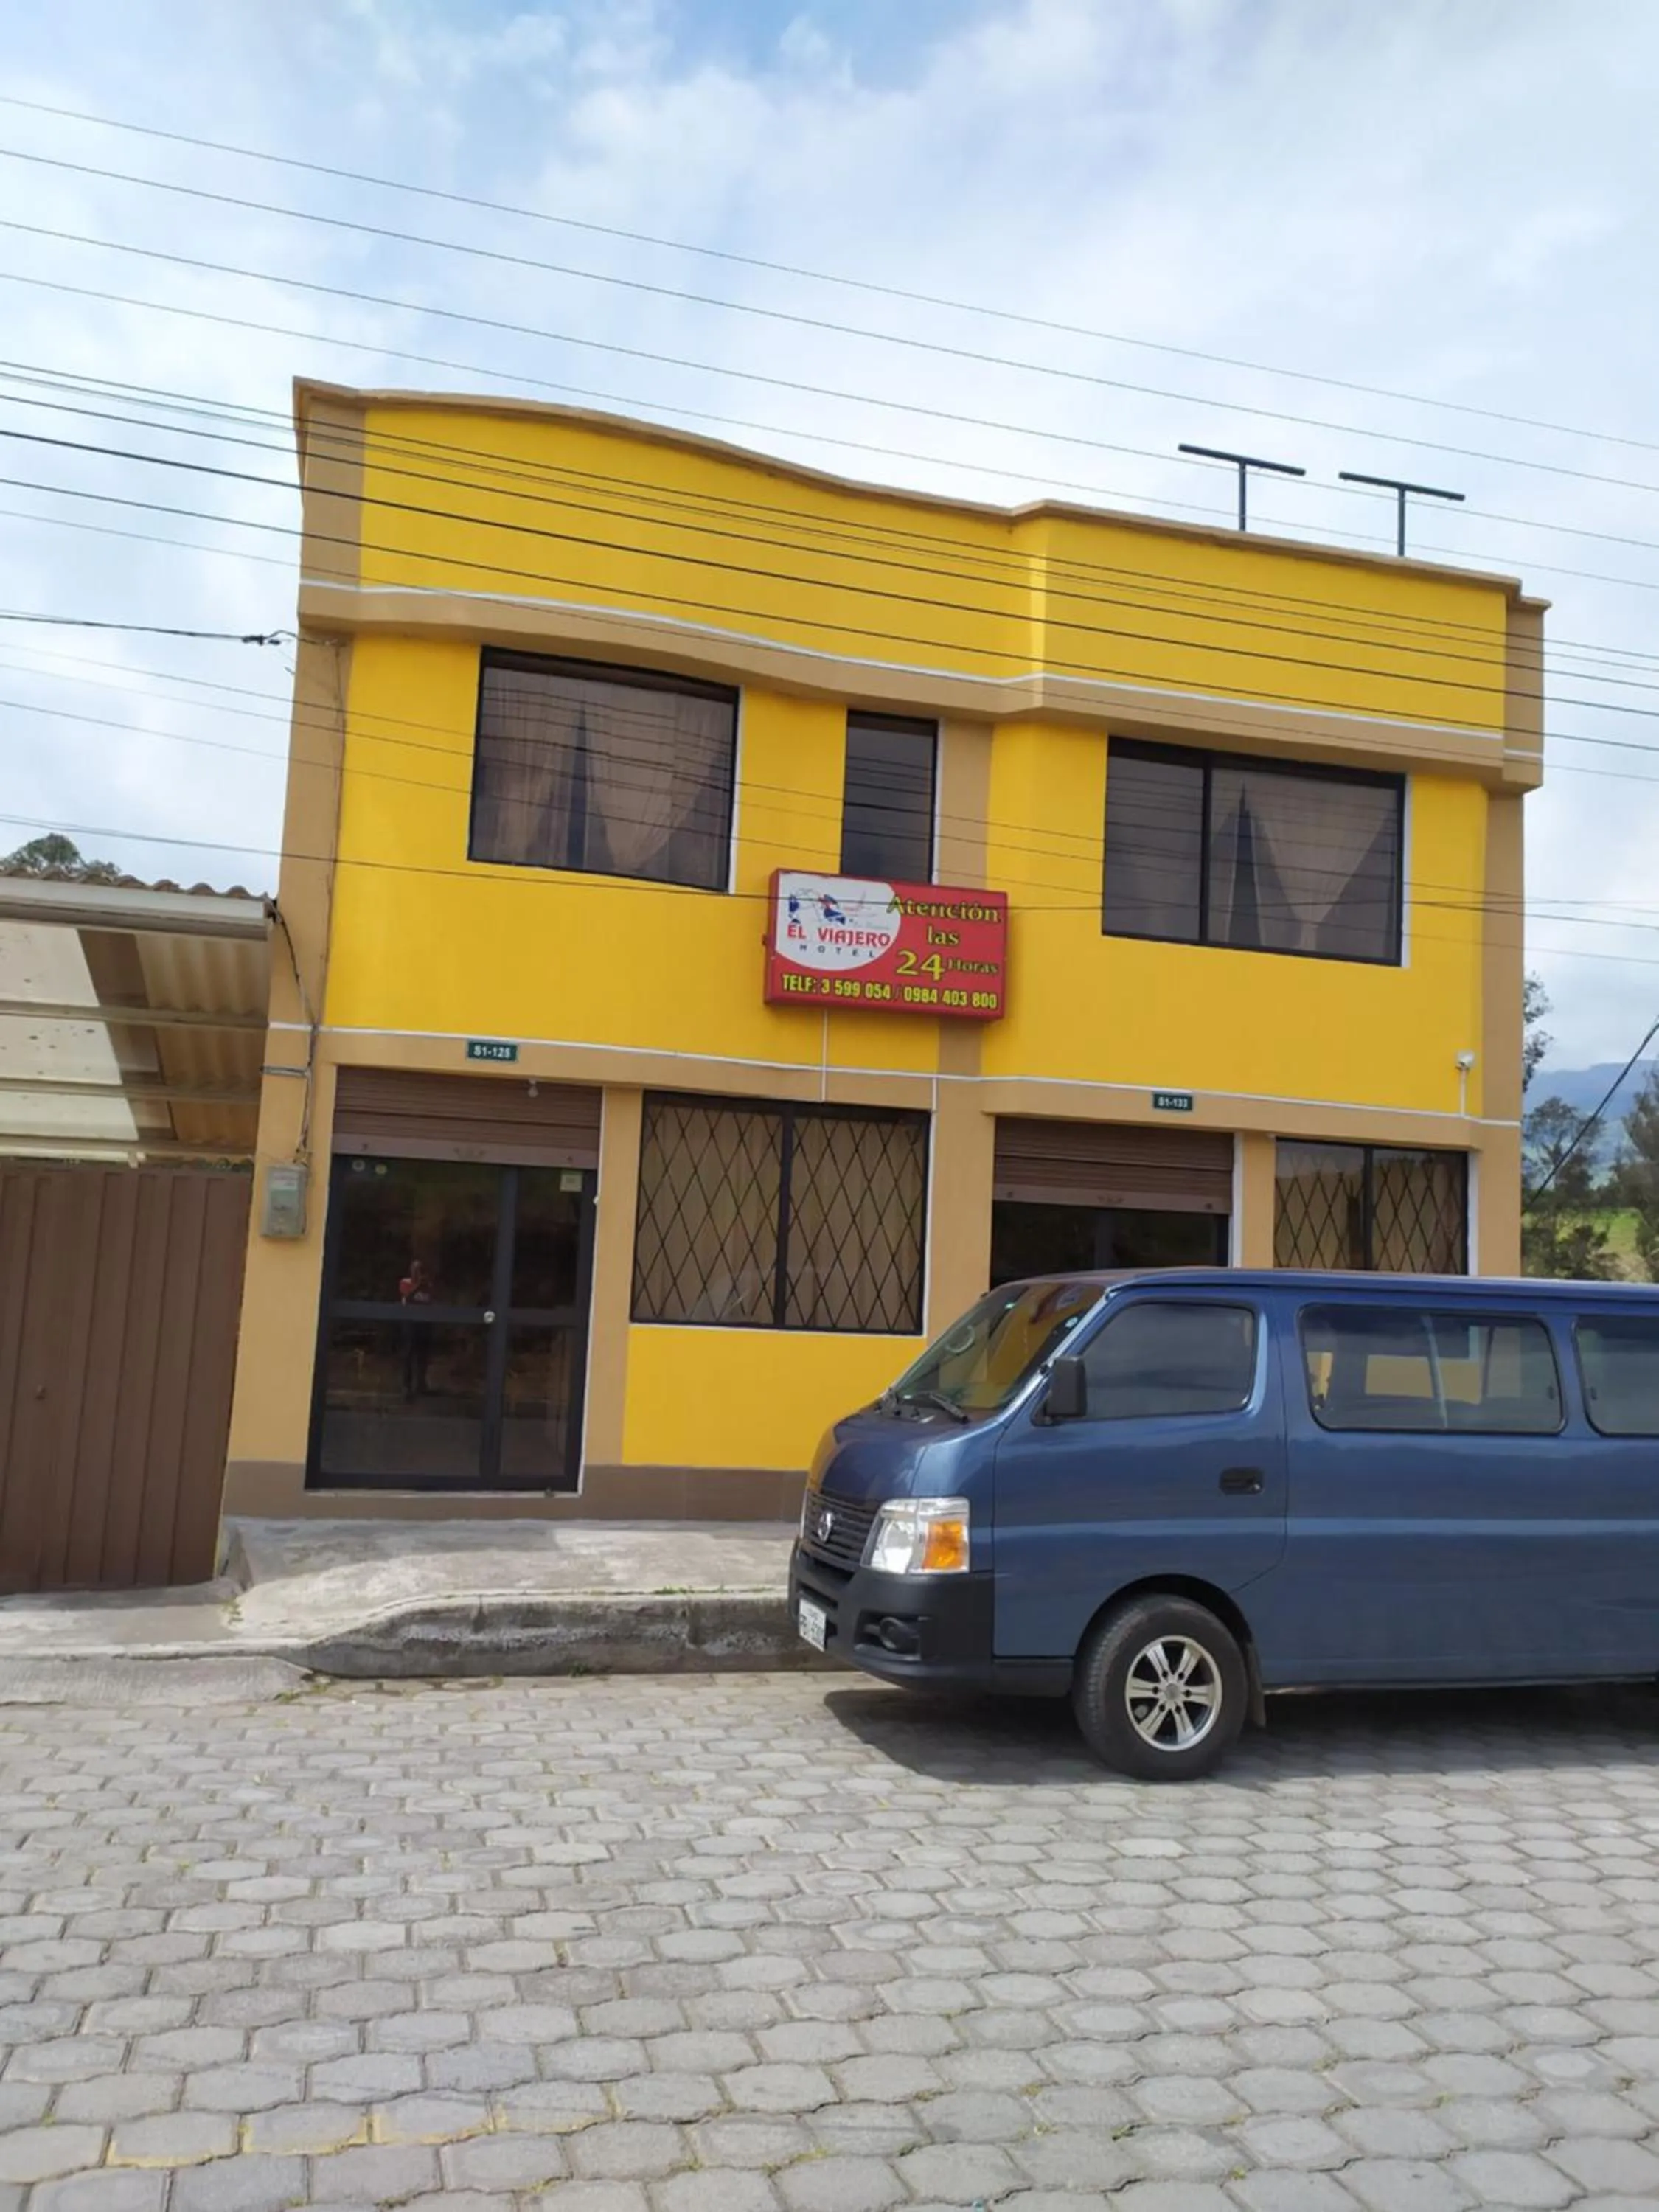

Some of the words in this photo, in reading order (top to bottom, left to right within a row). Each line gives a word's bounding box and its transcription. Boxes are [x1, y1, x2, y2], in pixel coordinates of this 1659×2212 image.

[886, 896, 1001, 922] Atención
[787, 923, 807, 939] EL
[818, 927, 891, 947] VIAJERO
[926, 925, 960, 946] las
[799, 943, 875, 958] HOTEL
[895, 950, 946, 981] 24
[947, 957, 998, 974] Horas
[782, 973, 817, 993] TELF:
[821, 978, 830, 995] 3
[834, 979, 861, 998] 599
[865, 982, 891, 1000] 054
[903, 986, 938, 1004] 0984
[942, 989, 967, 1006] 403
[972, 992, 998, 1009] 800
